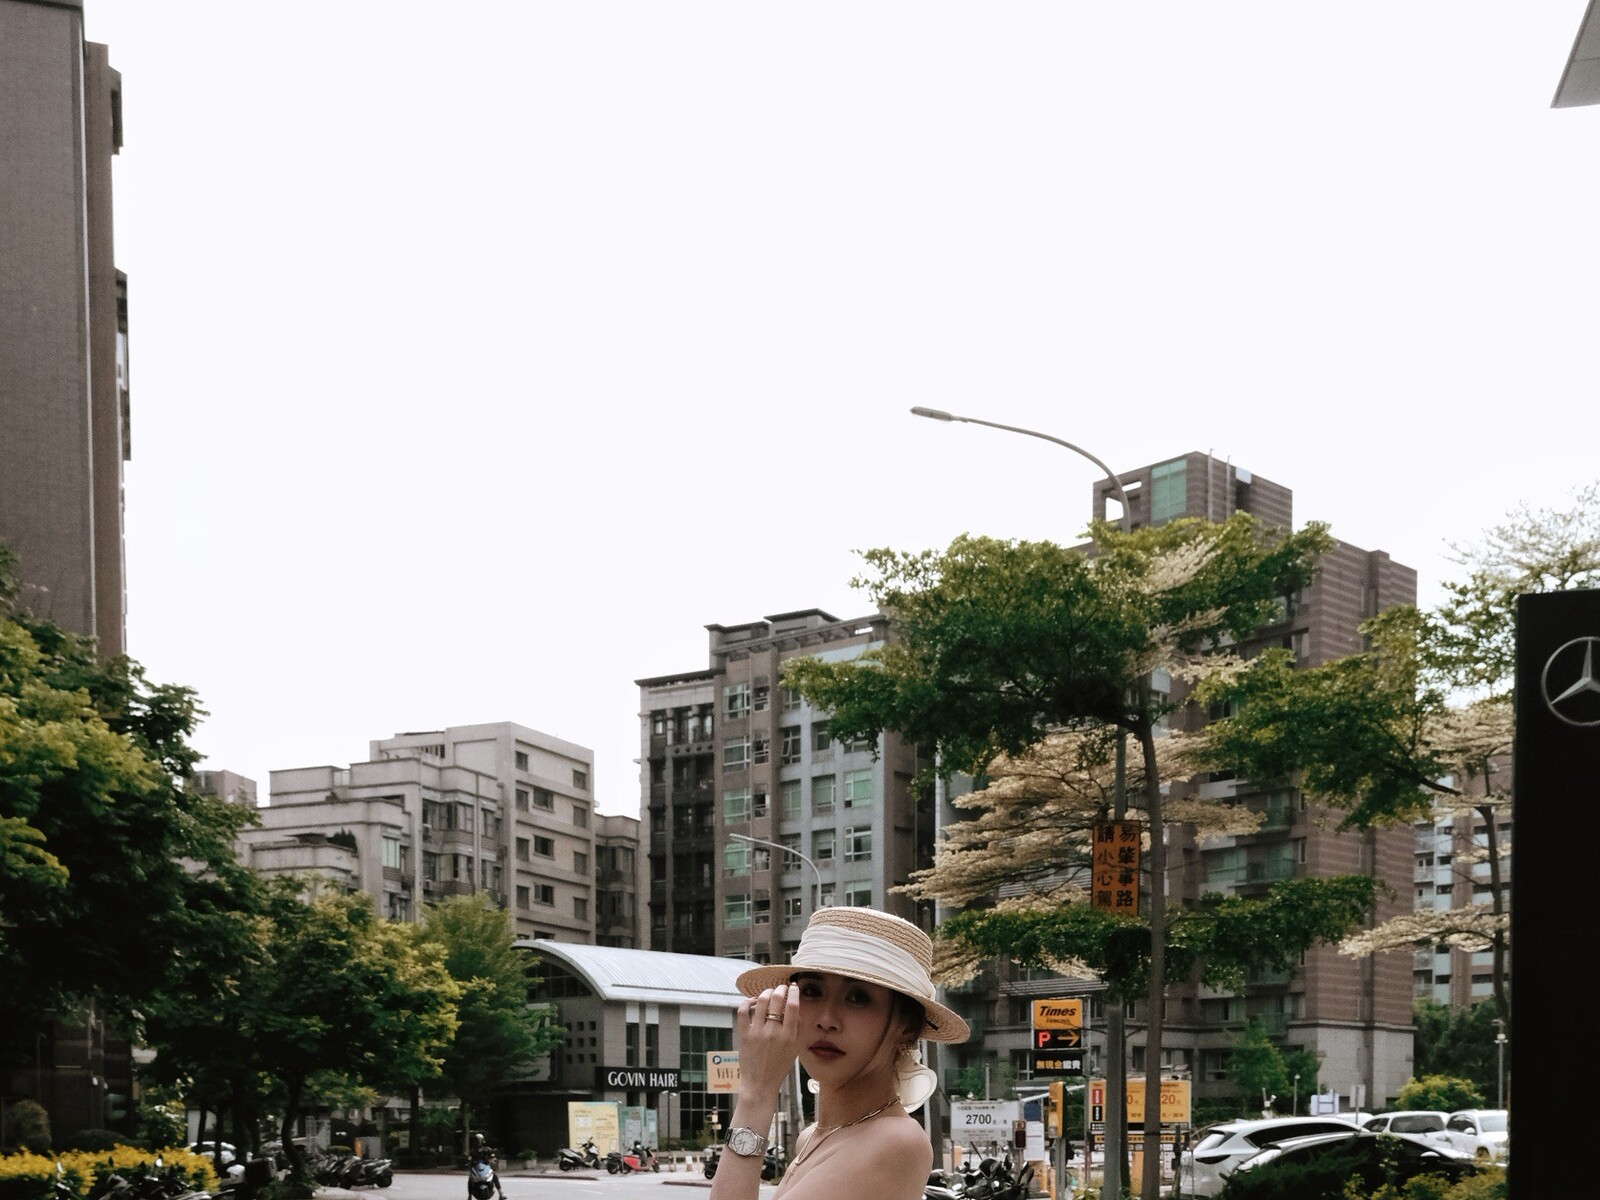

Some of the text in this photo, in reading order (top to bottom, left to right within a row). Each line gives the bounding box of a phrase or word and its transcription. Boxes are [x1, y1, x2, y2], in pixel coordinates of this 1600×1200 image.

[1117, 823, 1135, 916] 易肇事路
[1040, 1006, 1077, 1016] Times
[1038, 1031, 1051, 1048] P
[608, 1071, 645, 1087] GOVIN
[650, 1072, 675, 1088] HAIR
[1162, 1094, 1176, 1105] 20
[966, 1114, 992, 1125] 2700
